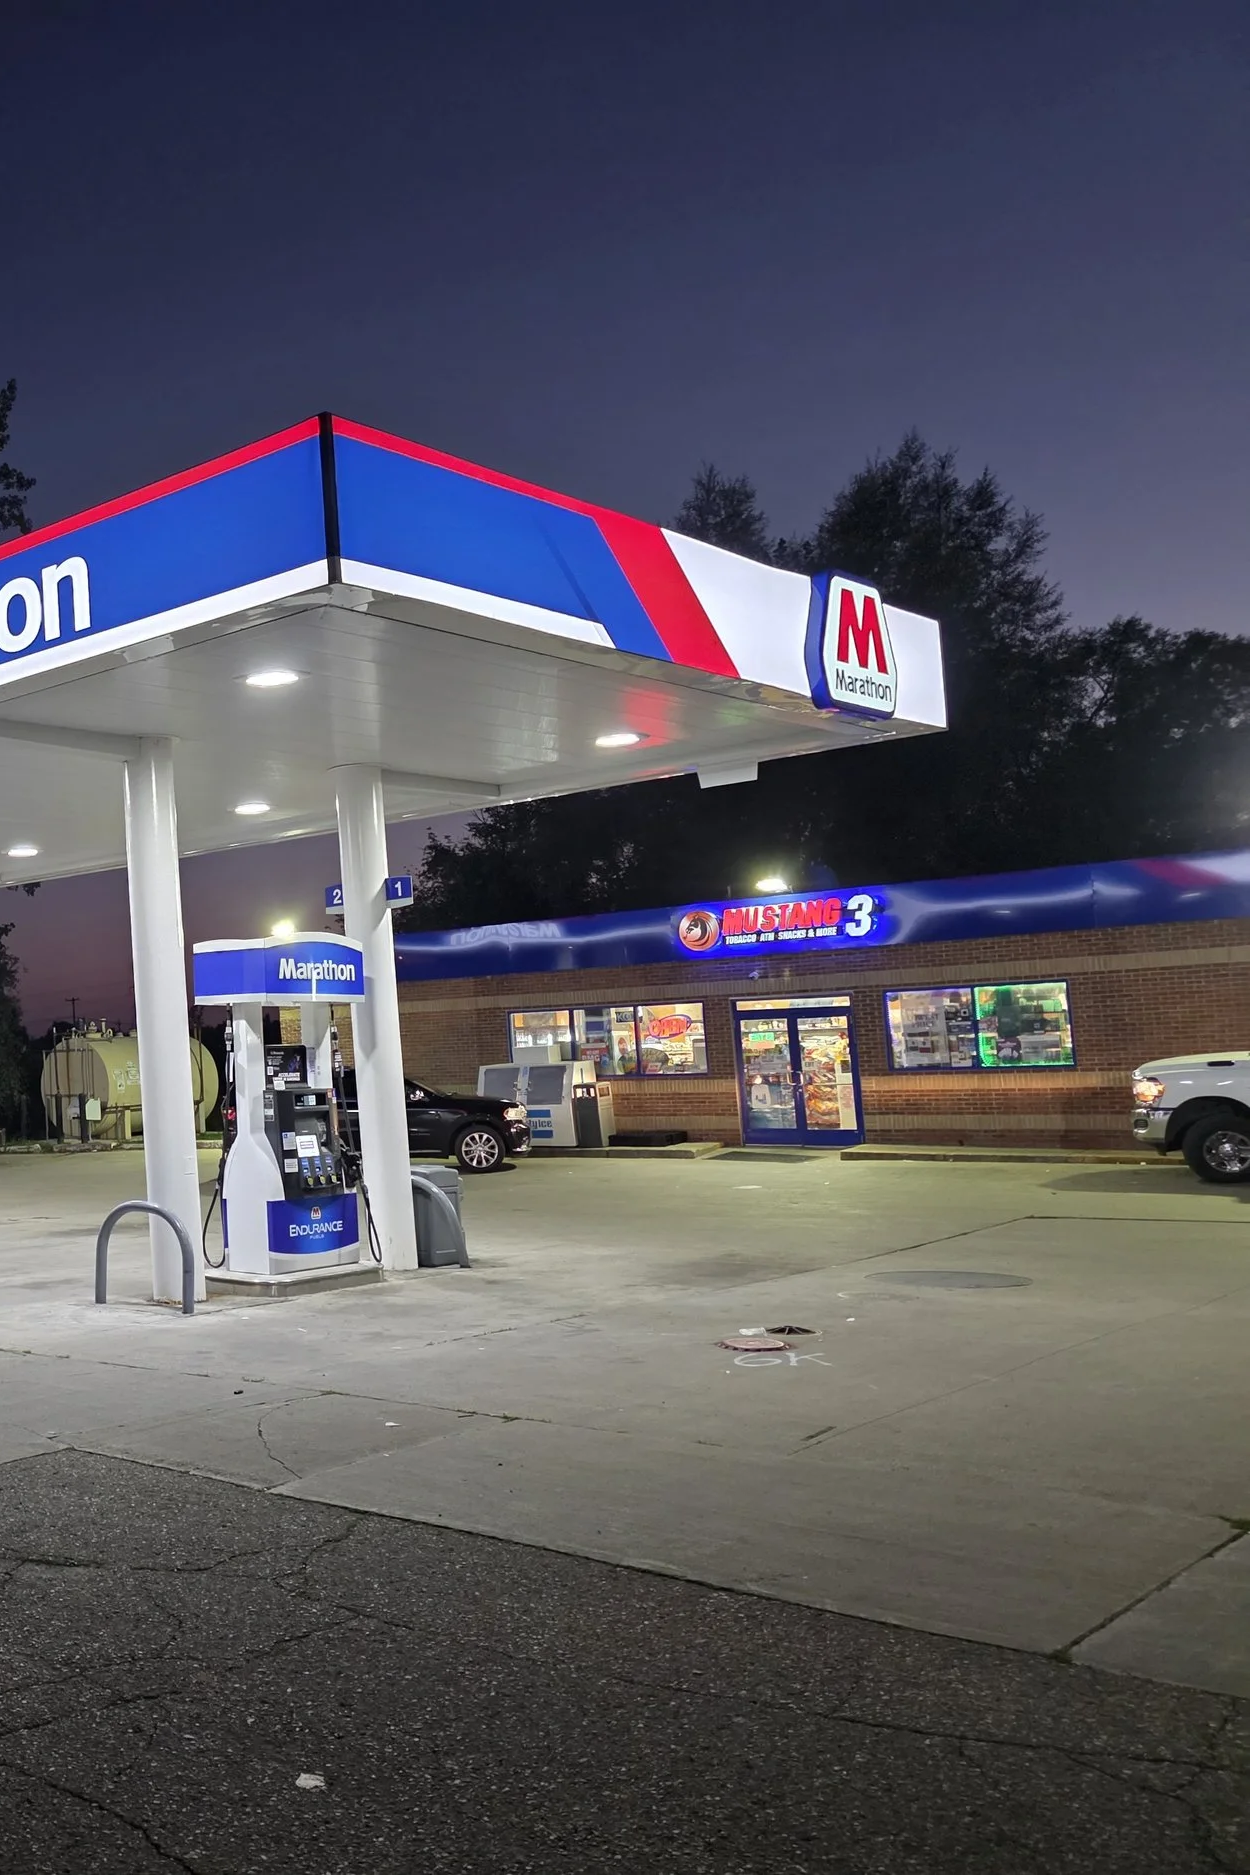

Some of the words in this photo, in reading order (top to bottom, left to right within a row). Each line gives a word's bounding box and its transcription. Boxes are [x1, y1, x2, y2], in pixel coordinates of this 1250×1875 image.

[837, 588, 889, 675] M
[836, 668, 892, 702] Marathon
[332, 888, 342, 904] 2
[394, 881, 402, 897] 1
[722, 898, 842, 936] MUSTANG
[845, 894, 874, 937] 3
[725, 934, 756, 945] TOBACCO
[759, 932, 775, 942] ATM
[778, 929, 807, 940] SNACKS
[807, 928, 815, 938] &
[815, 926, 837, 937] MORE
[279, 958, 355, 981] Marathon
[649, 1018, 687, 1036] OPEN
[289, 1220, 344, 1237] ENDURANCE
[734, 1352, 834, 1367] OK
